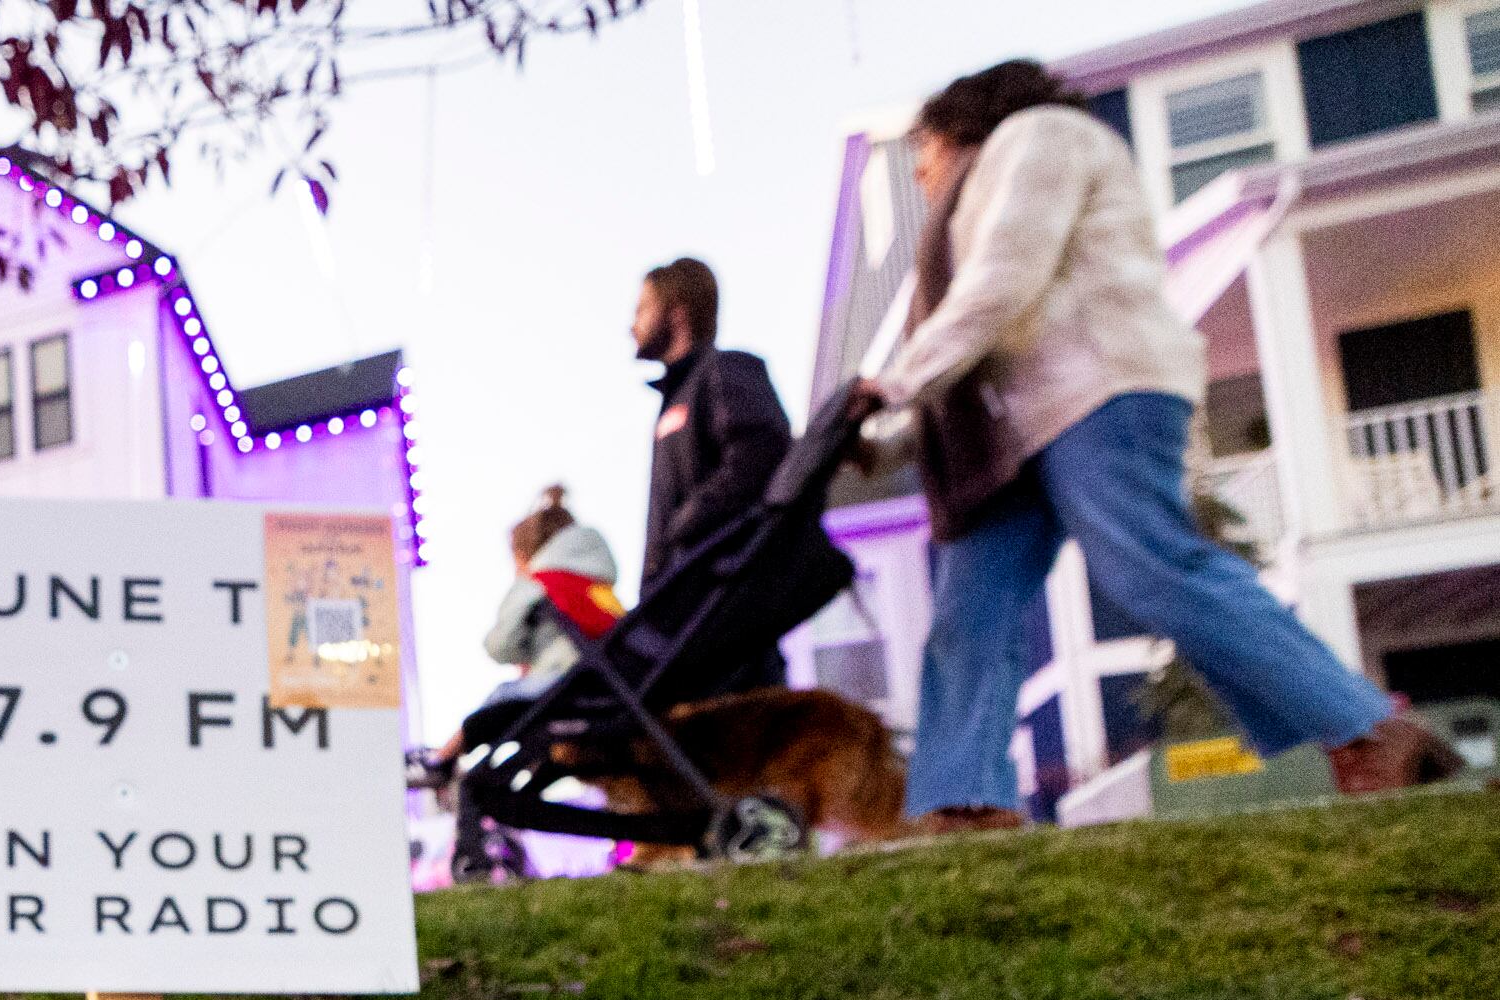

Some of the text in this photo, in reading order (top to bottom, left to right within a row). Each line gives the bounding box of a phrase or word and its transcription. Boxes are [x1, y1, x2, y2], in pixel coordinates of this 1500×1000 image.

[212, 580, 259, 625] T
[187, 691, 331, 749] FM
[97, 830, 310, 873] YOUR
[94, 895, 361, 936] RADIO
